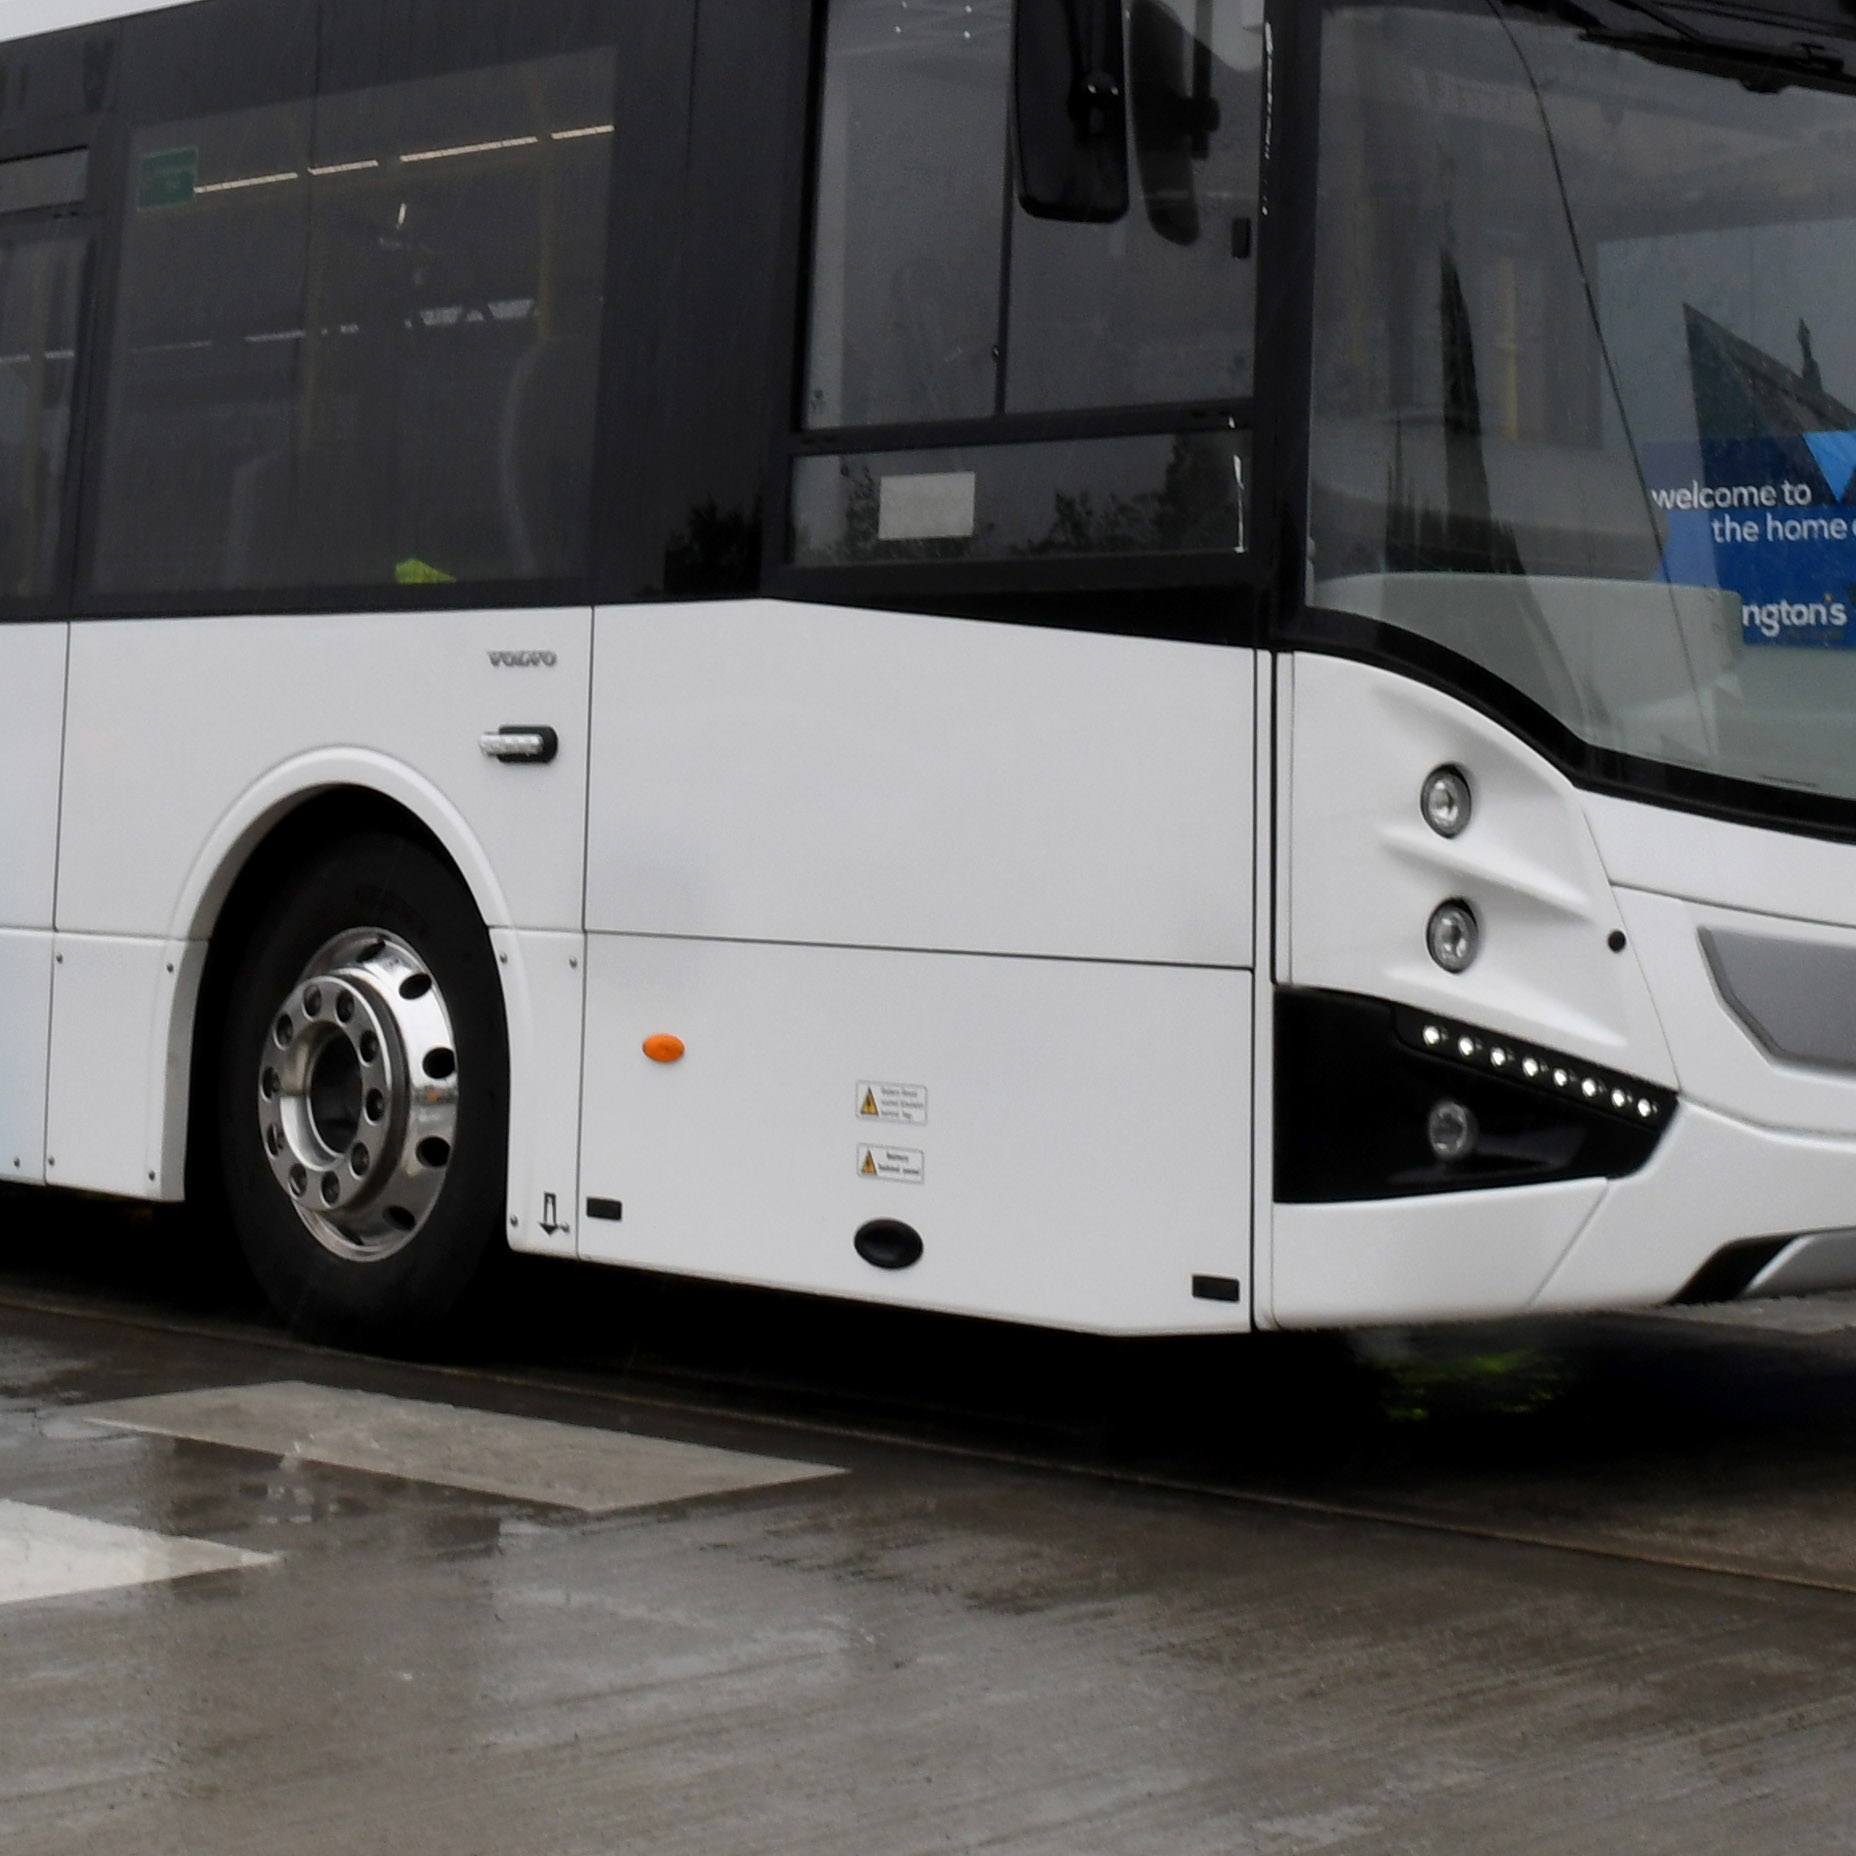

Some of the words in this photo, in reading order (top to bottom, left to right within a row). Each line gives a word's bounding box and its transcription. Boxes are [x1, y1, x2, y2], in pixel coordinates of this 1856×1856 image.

[1651, 481, 1777, 510] welcome
[1783, 481, 1813, 506] to
[1711, 514, 1760, 543] the
[1766, 513, 1848, 542] home
[1742, 593, 1848, 638] ngton's
[488, 650, 558, 667] VOLVO
